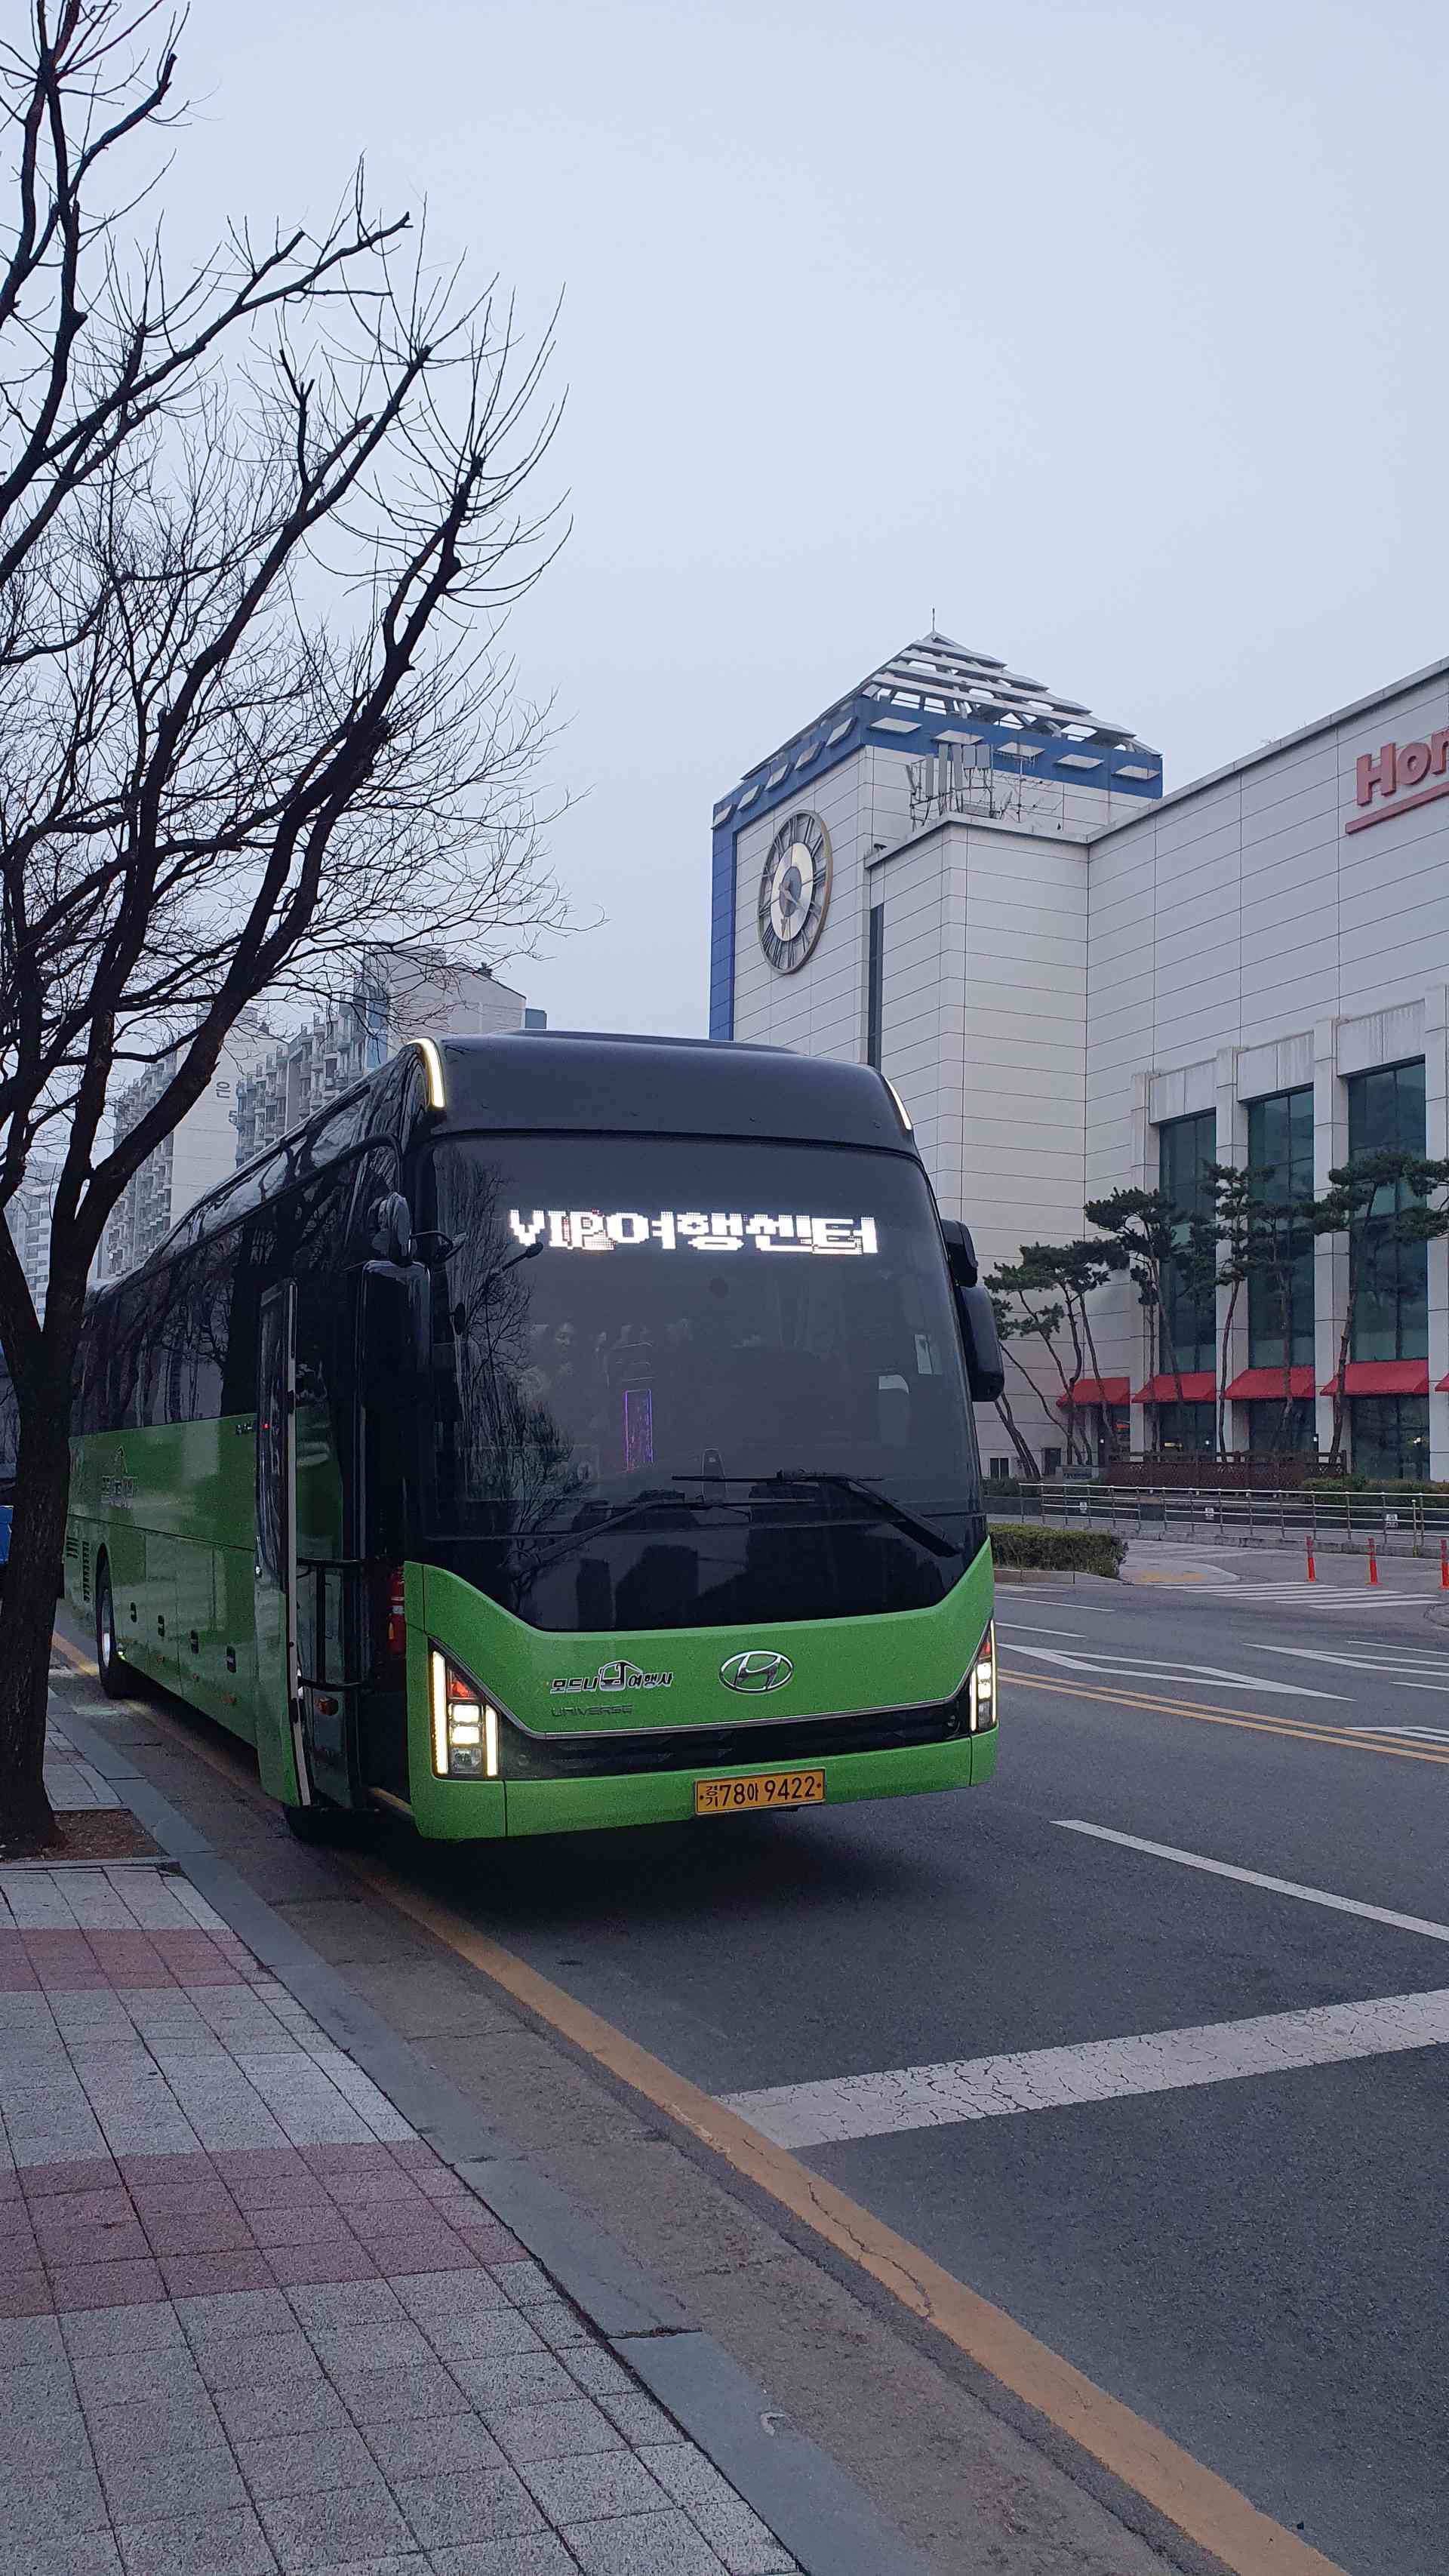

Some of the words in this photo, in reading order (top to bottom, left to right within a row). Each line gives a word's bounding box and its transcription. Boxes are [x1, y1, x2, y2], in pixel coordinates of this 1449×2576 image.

[627, 1671, 674, 1689] 여행사
[551, 1704, 633, 1717] UNIVERSE
[764, 1776, 815, 1802] 9422
